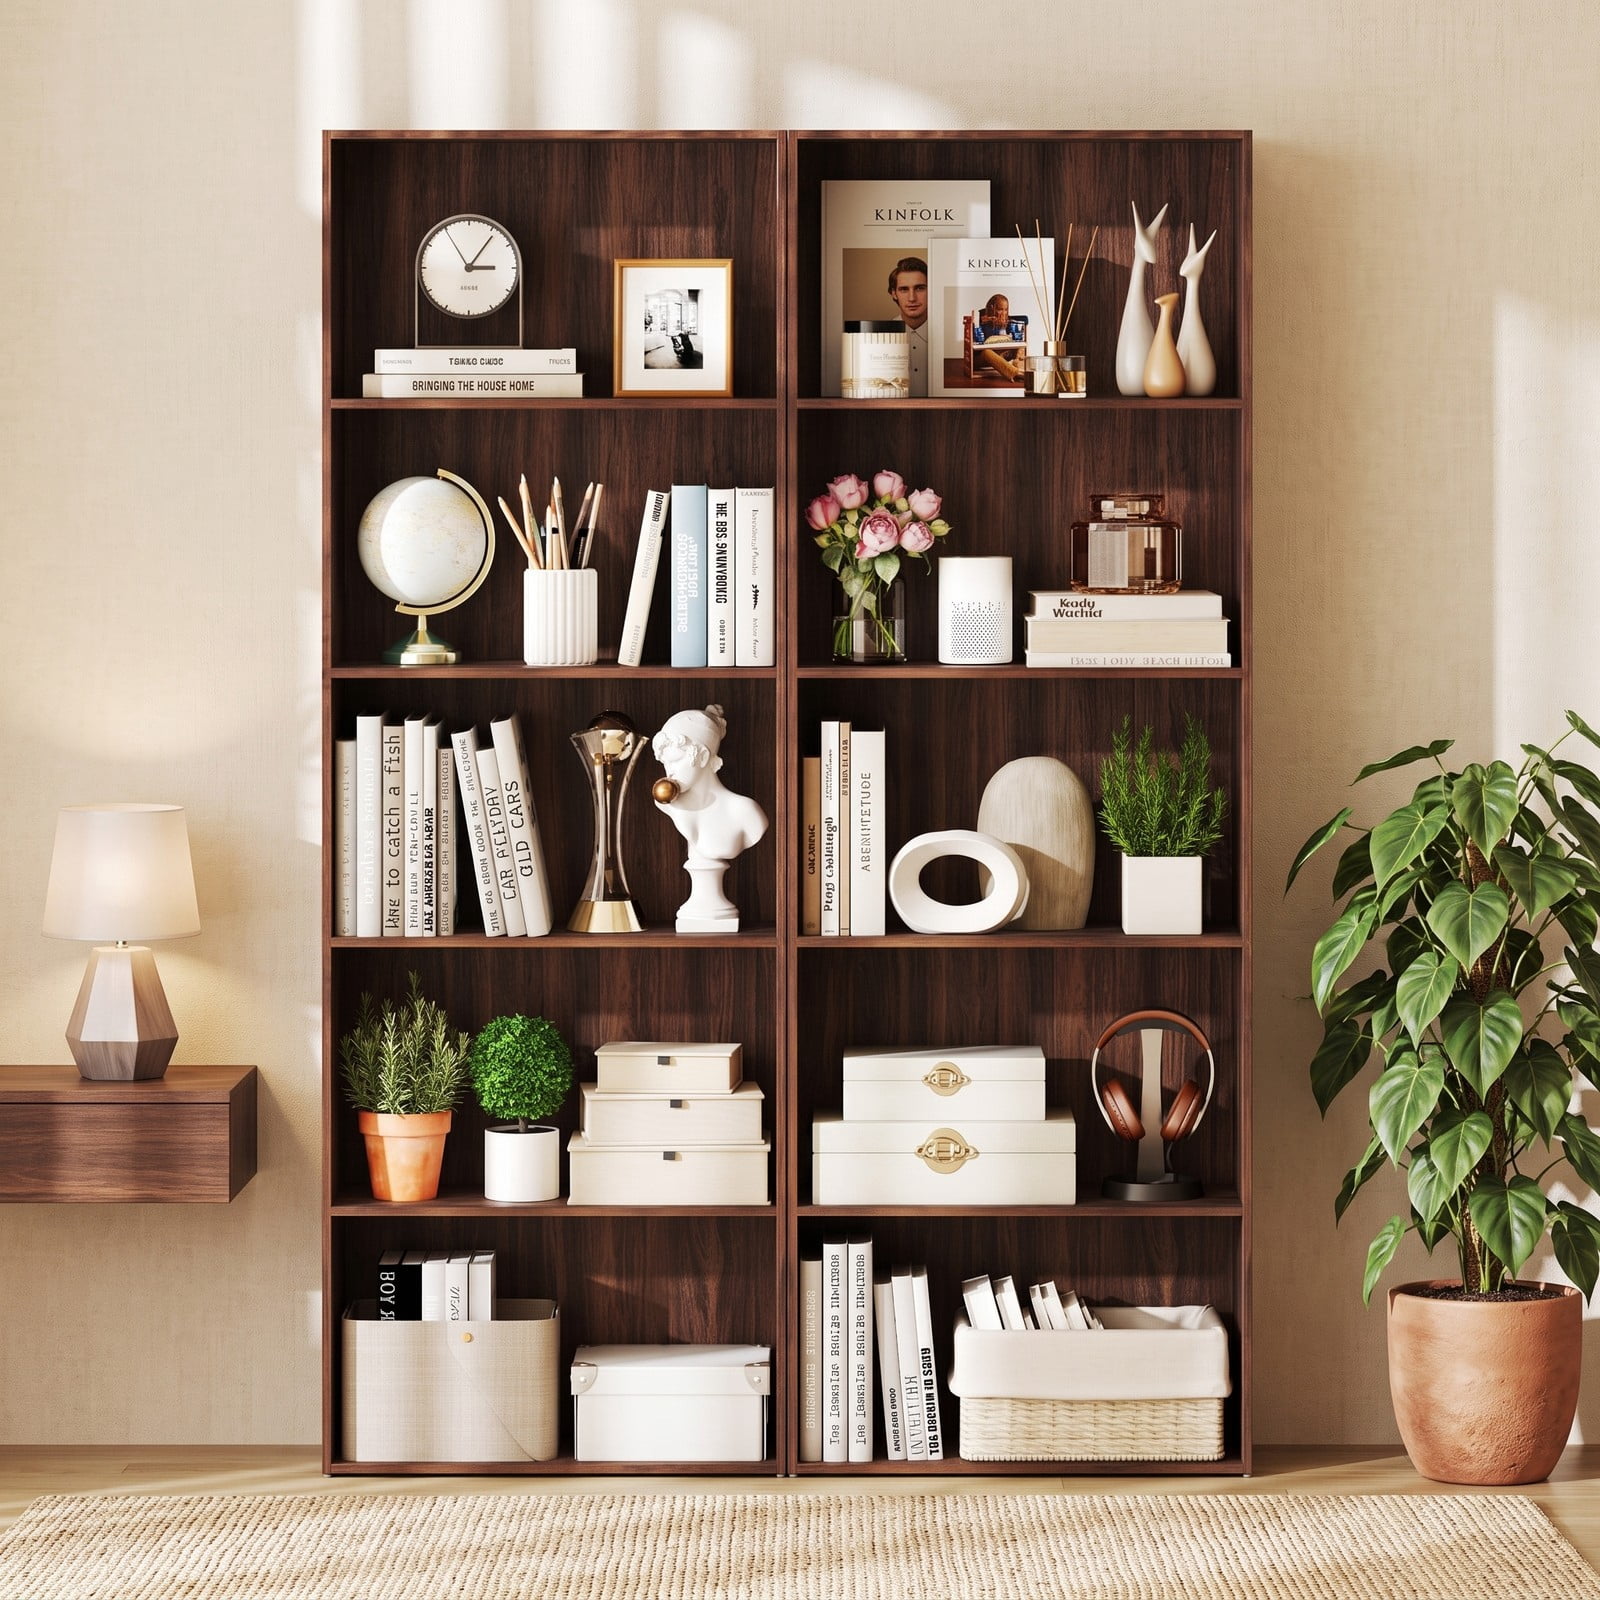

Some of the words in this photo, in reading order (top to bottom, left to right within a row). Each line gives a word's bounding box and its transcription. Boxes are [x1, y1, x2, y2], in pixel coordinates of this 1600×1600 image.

[875, 208, 954, 221] KINFOLK
[968, 258, 1028, 268] KINFOLK
[412, 380, 455, 391] BRINGING
[458, 380, 475, 391] THE
[477, 380, 507, 391] HOUSE
[509, 380, 535, 391] HOME
[384, 734, 401, 775] fish
[388, 786, 401, 796] a
[504, 780, 524, 829] CARS
[384, 806, 401, 858] catch
[386, 868, 401, 888] to
[379, 1271, 396, 1305] BOY
